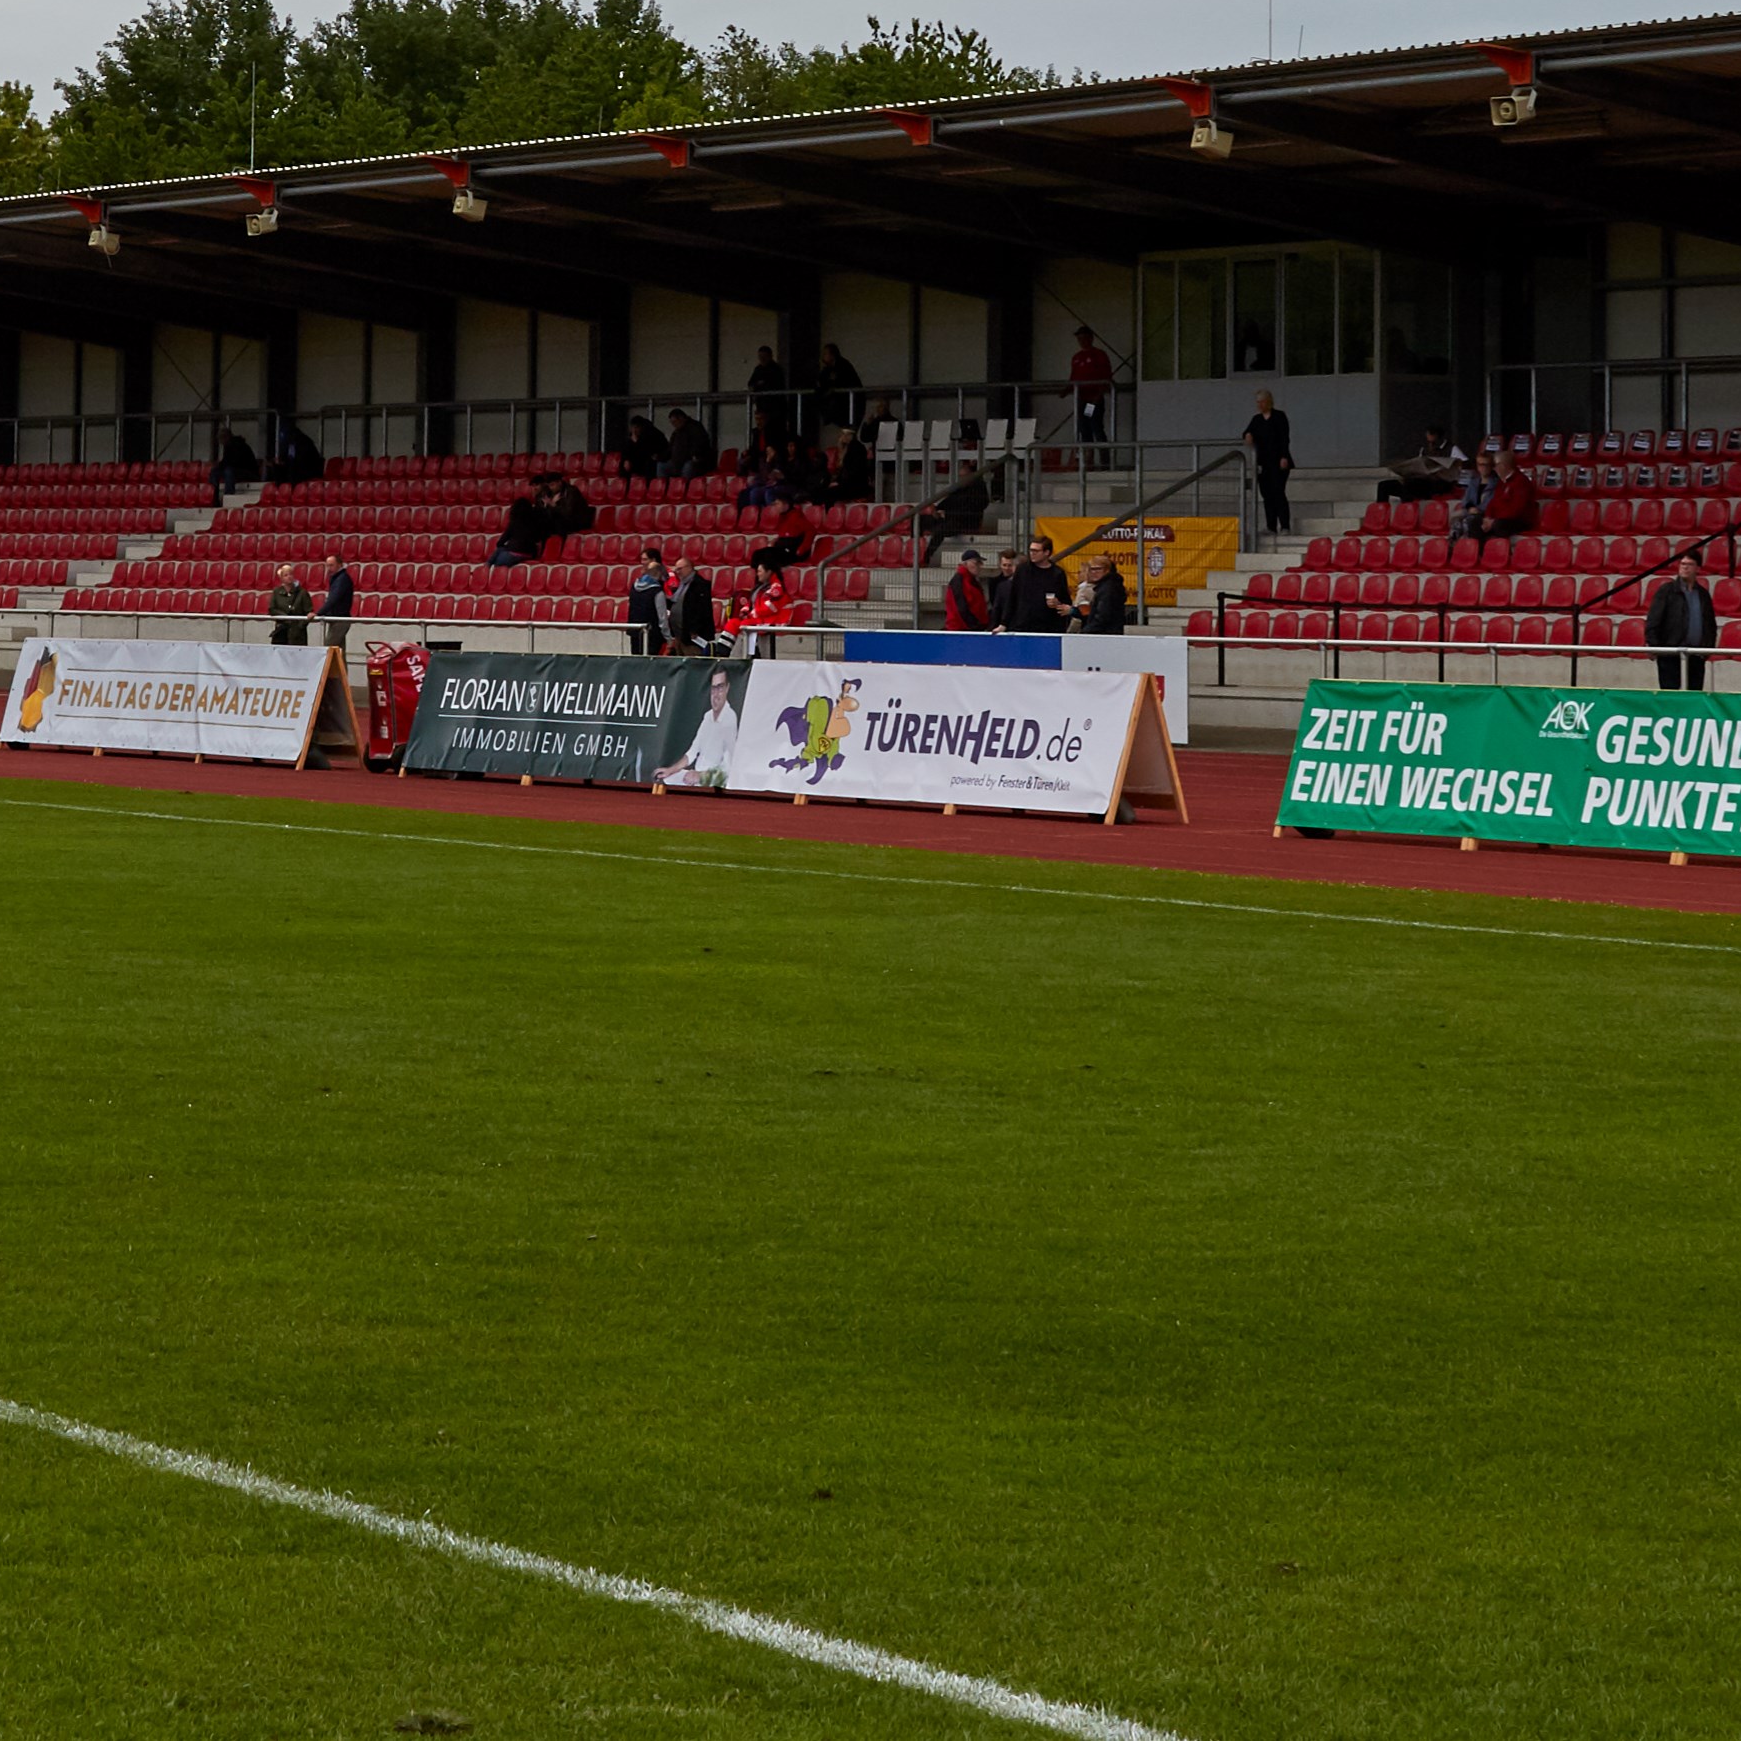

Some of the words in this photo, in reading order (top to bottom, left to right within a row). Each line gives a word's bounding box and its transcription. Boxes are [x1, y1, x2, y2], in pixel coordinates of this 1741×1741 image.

[58, 679, 153, 710] FINALTAG
[154, 682, 196, 713] DER
[195, 685, 306, 719] AMATEURE
[440, 678, 527, 713] FLORIAN
[543, 681, 666, 719] WELLMANN
[1542, 700, 1595, 731] AOK
[451, 727, 567, 755] IMMOBILIEN
[573, 733, 629, 758] GMBH
[1302, 708, 1377, 752] ZEIT
[1379, 701, 1447, 755] FÜR
[950, 773, 986, 788] powered
[986, 773, 997, 790] by
[1290, 760, 1393, 806] EINEN
[1399, 766, 1554, 817] WECHSEL
